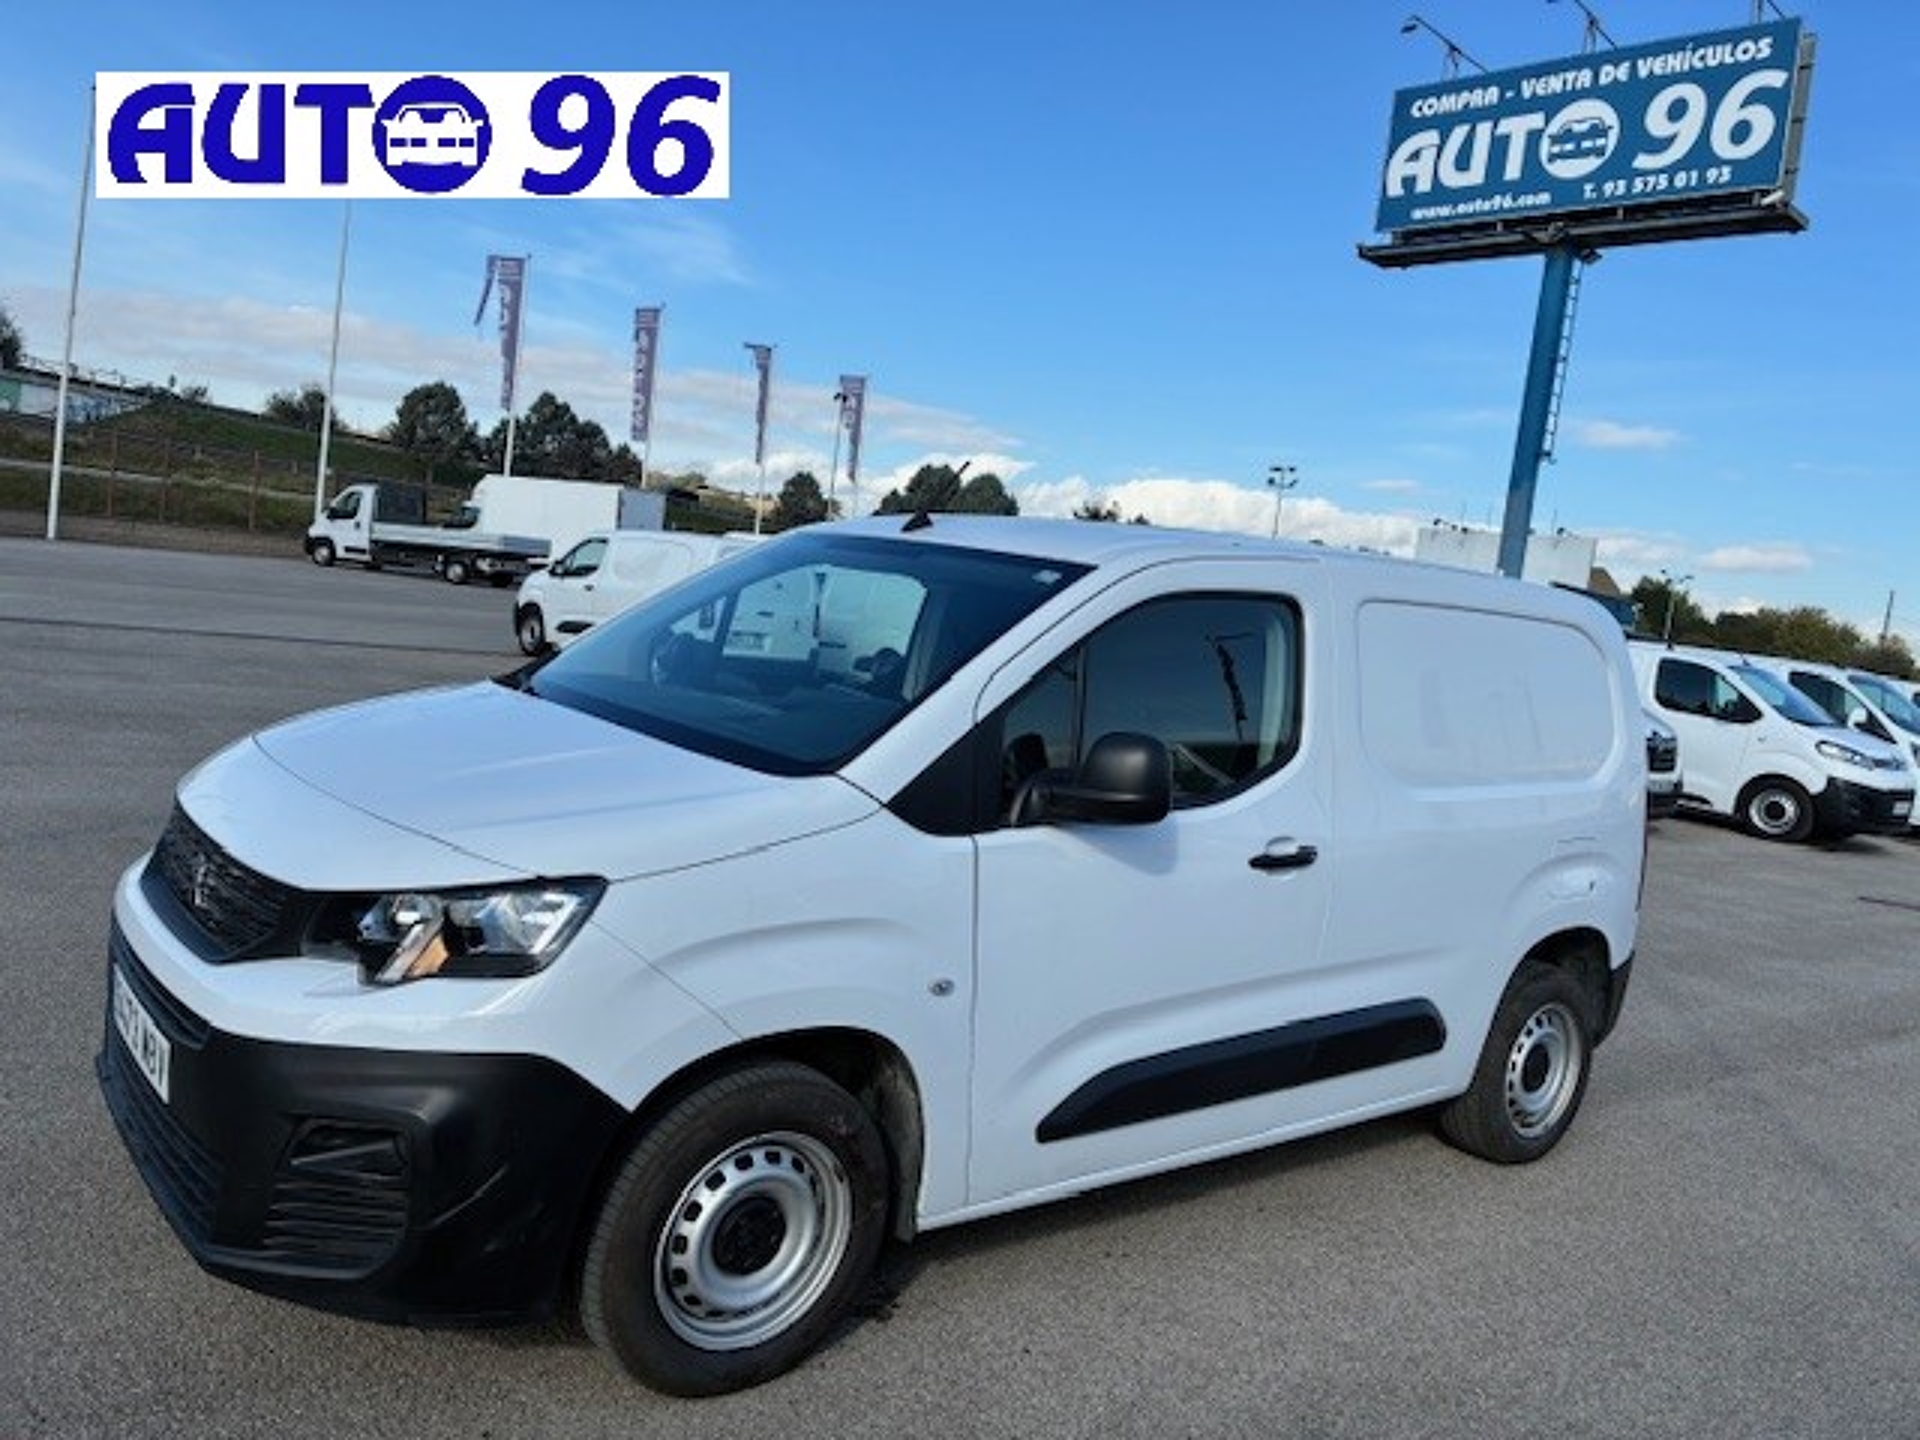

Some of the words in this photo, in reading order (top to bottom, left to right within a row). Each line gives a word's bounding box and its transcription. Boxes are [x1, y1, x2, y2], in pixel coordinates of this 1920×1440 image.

[1410, 86, 1500, 118] COMPRA
[1520, 69, 1592, 100] VENTA
[1598, 60, 1630, 86] DE
[1636, 36, 1774, 80] VEHÍCULOS
[1631, 69, 1789, 170] 96
[1410, 191, 1552, 220] www.auto96.com
[1583, 183, 1597, 200] T.
[1602, 179, 1627, 198] 93
[1631, 173, 1669, 194] 575
[1673, 170, 1699, 189] 01
